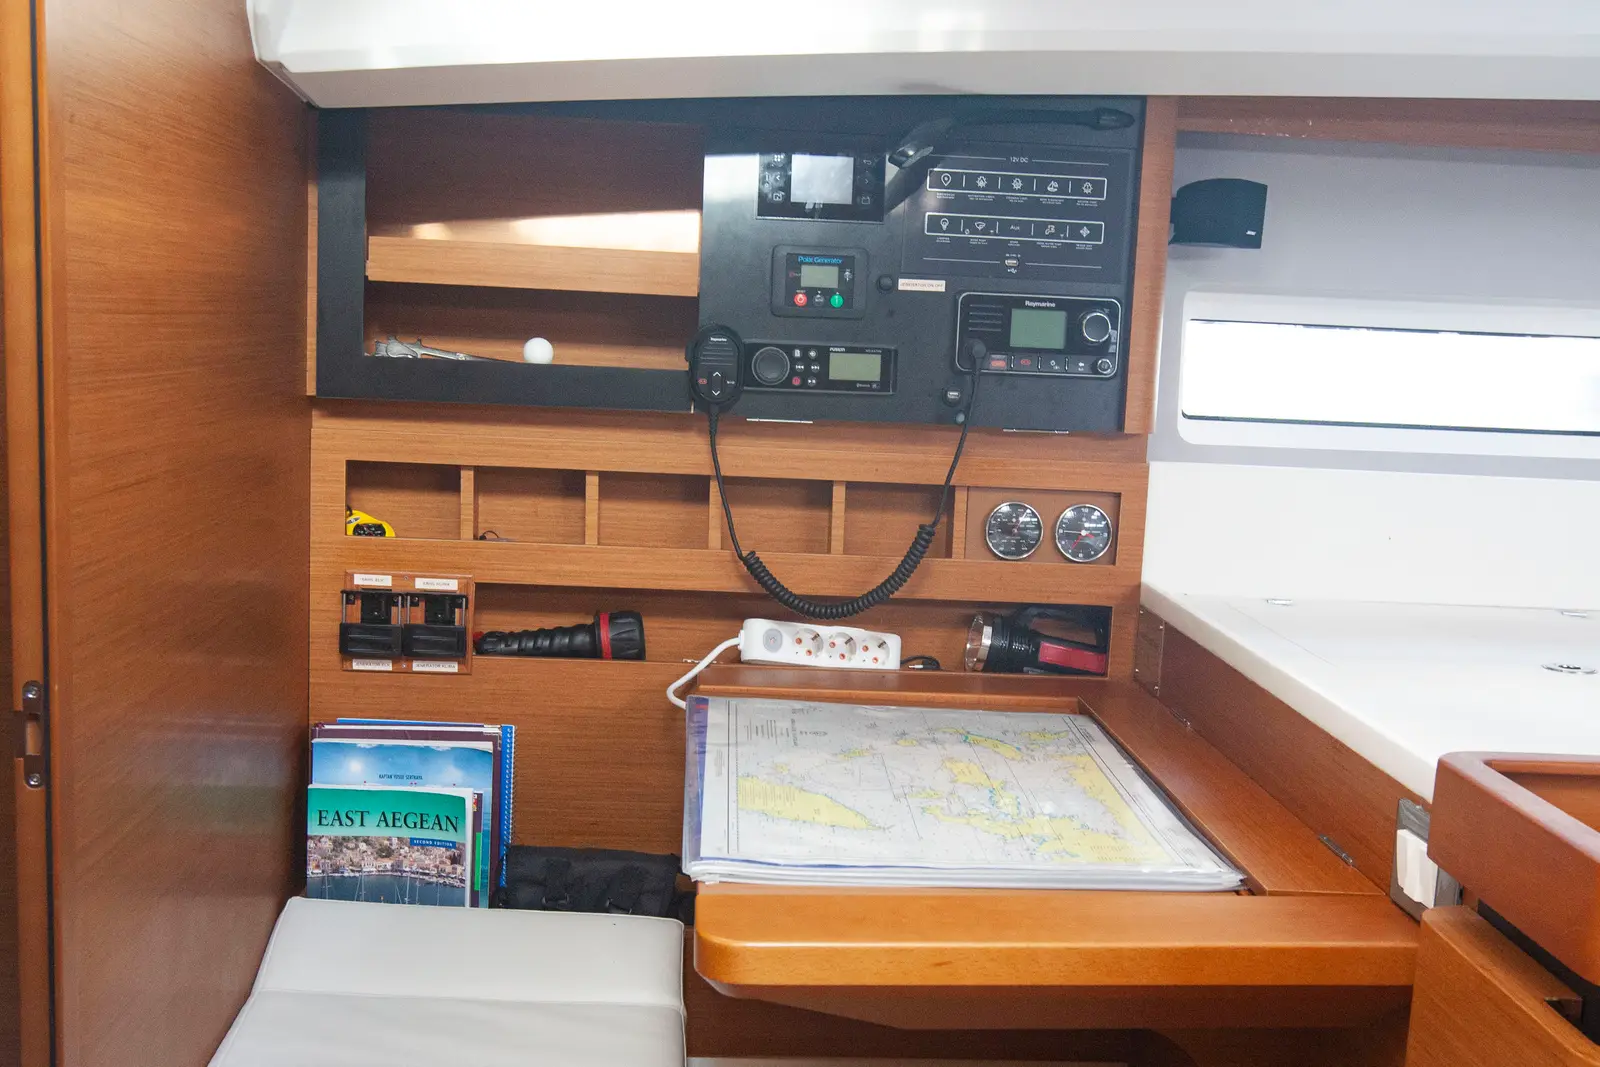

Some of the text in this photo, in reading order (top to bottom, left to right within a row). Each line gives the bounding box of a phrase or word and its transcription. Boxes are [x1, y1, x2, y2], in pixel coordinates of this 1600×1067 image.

[814, 256, 843, 265] Generator
[1025, 300, 1056, 308] Raymarine
[317, 809, 460, 833] EAST AEGEAN
